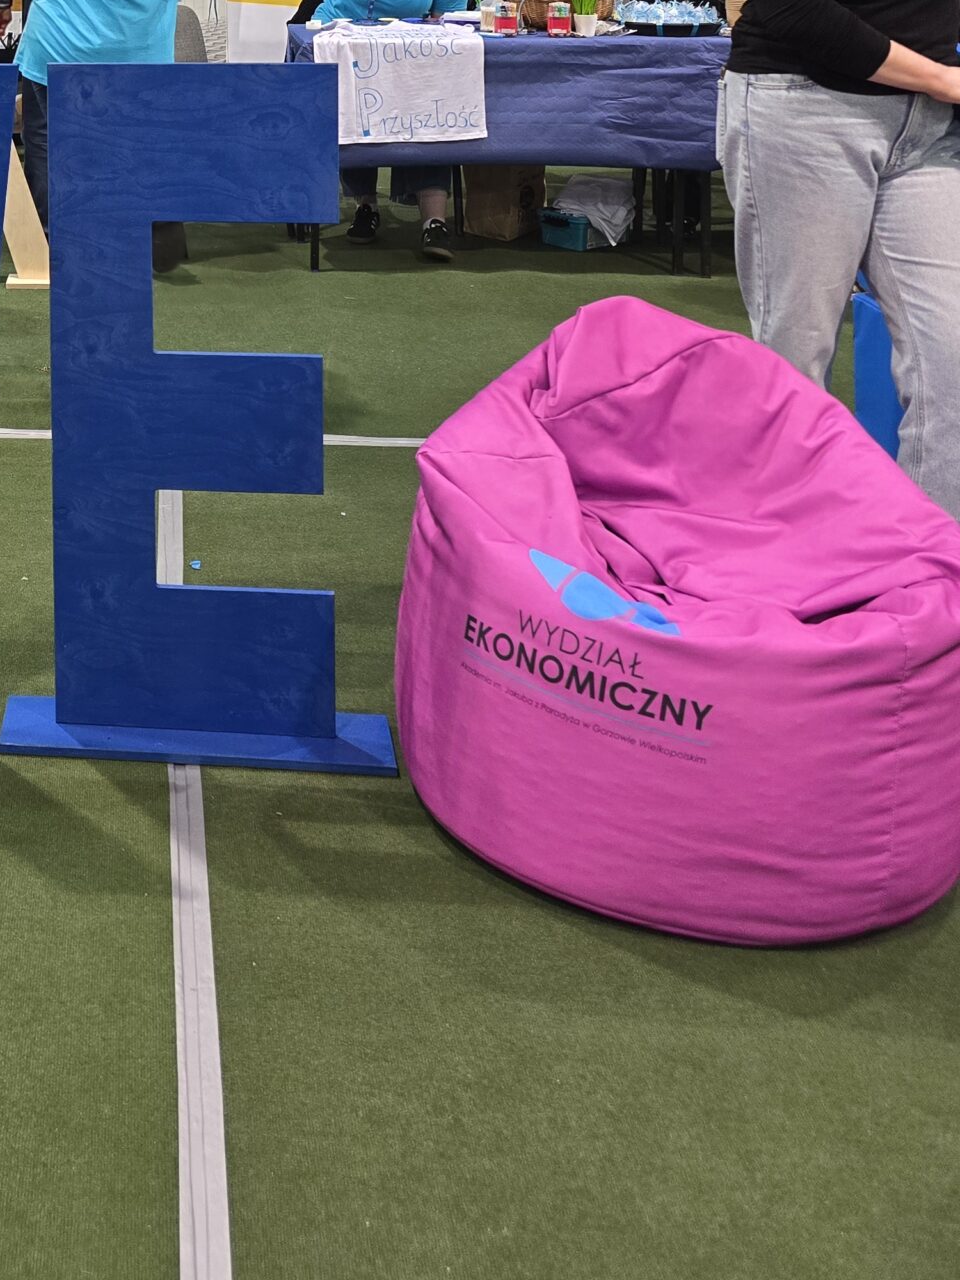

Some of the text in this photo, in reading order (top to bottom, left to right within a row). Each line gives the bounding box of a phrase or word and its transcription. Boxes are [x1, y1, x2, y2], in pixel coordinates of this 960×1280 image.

[464, 614, 713, 731] EKONOMICZNY
[519, 609, 644, 680] WYDZIAŁ
[592, 724, 707, 764] Gorzowie Wielkopolskim
